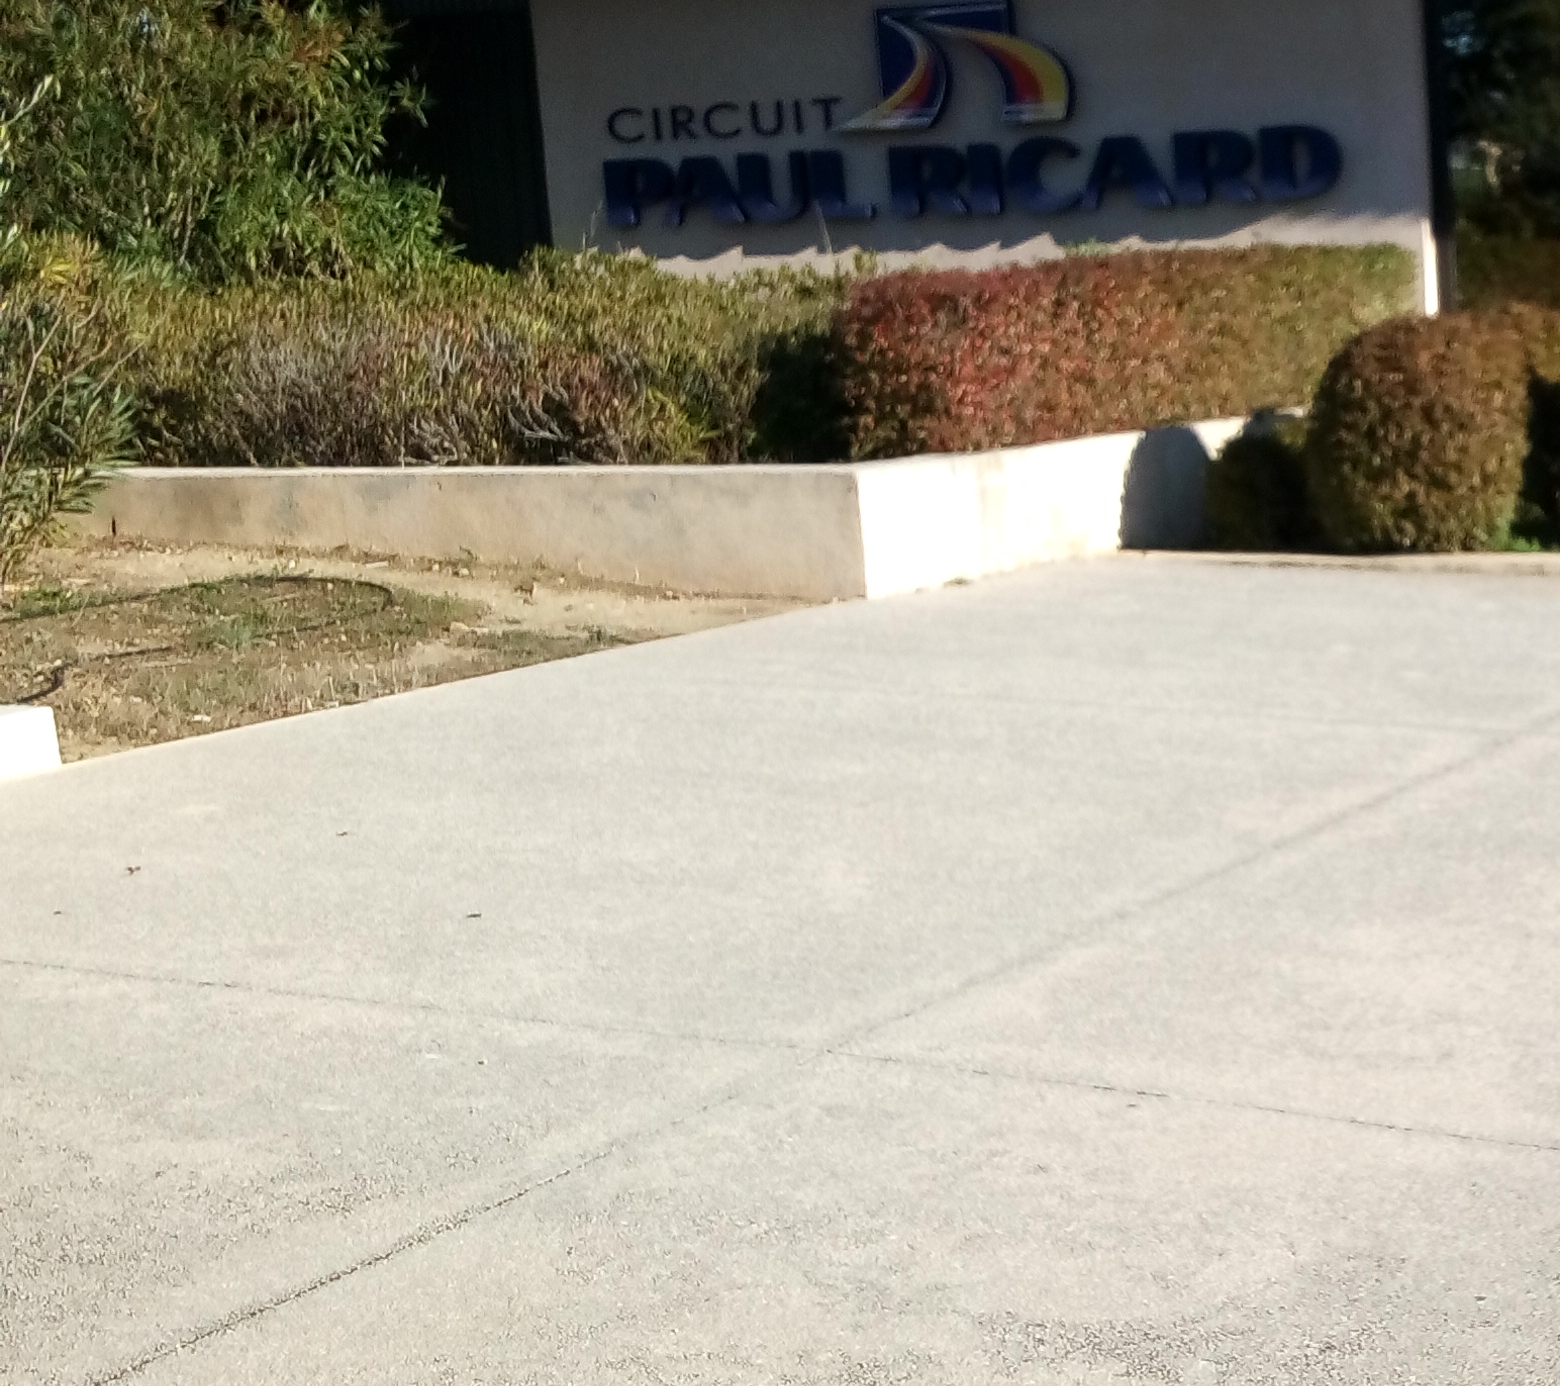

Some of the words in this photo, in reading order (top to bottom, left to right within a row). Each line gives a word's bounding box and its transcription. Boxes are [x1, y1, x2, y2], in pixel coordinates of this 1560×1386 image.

[606, 95, 844, 144] CIRCUIT
[602, 148, 876, 228] PAUL
[887, 124, 1344, 216] RICARD
